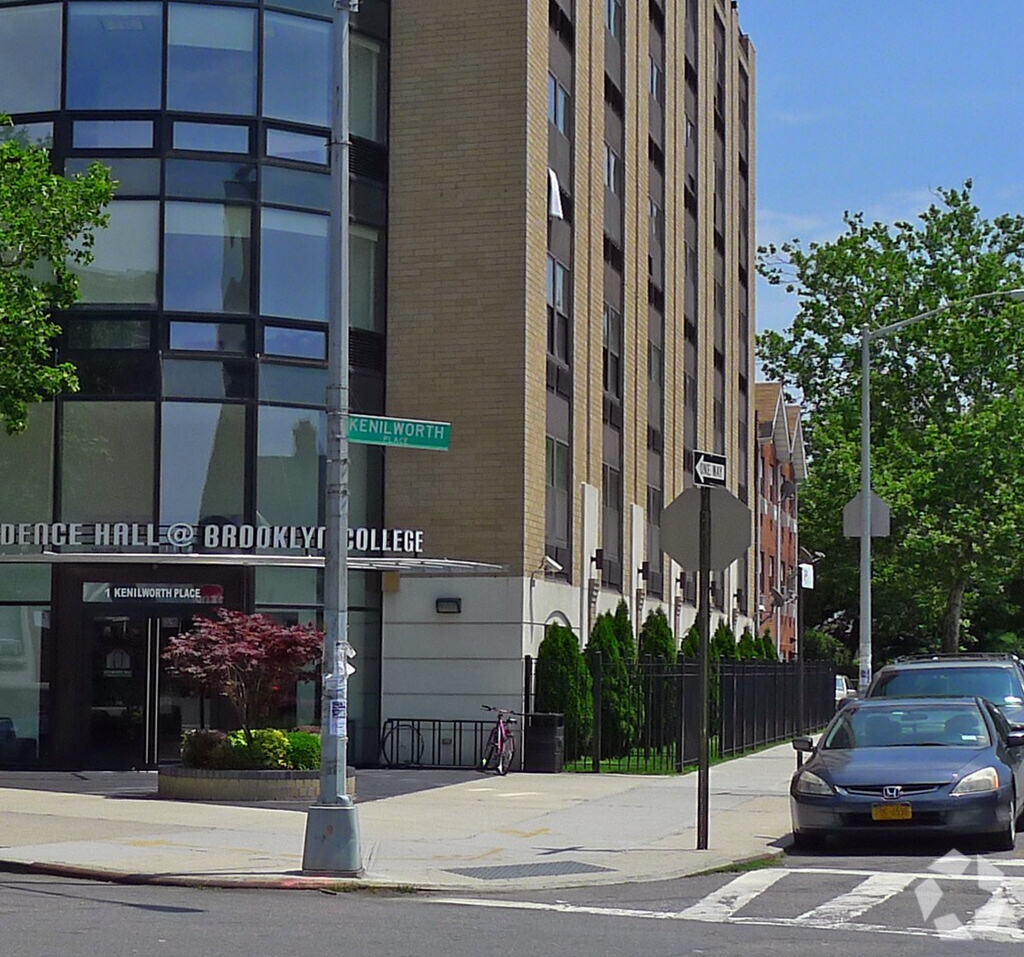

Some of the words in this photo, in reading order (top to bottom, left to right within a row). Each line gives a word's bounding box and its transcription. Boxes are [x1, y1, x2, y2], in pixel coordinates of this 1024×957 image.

[349, 417, 445, 439] KENILWORTH
[383, 435, 409, 445] PLACE
[94, 522, 161, 547] HALL
[166, 522, 195, 547] @
[347, 527, 424, 553] COLLEGE
[105, 588, 111, 598] 1
[114, 587, 173, 598] KENILWORTH
[174, 587, 201, 598] PLACE
